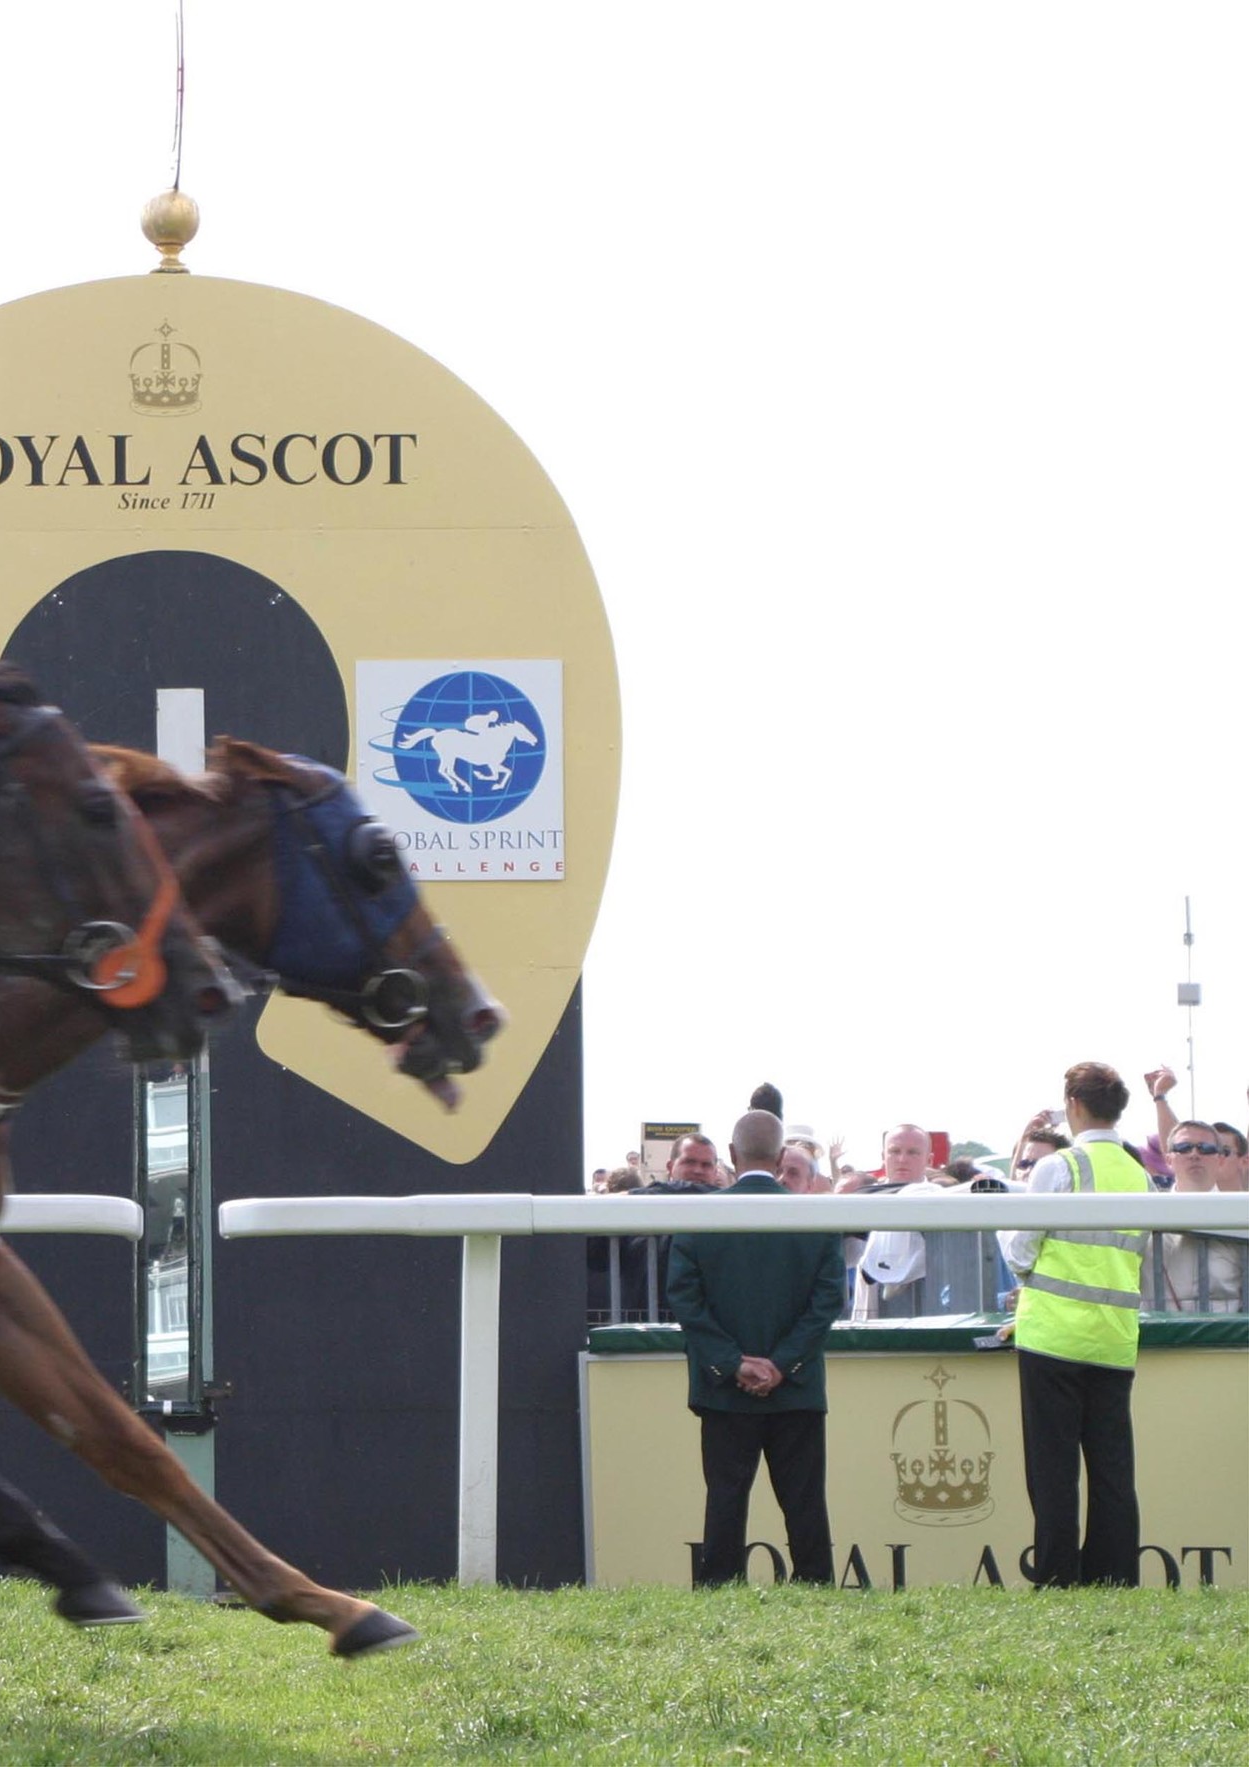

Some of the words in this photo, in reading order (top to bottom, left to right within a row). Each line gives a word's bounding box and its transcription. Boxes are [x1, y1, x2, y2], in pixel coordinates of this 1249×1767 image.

[177, 432, 418, 486] ASCOT
[117, 491, 171, 510] Since
[180, 491, 216, 510] 1711
[392, 830, 459, 851] OBAL
[468, 829, 563, 850] SPRINT
[409, 861, 564, 873] ALLENGE
